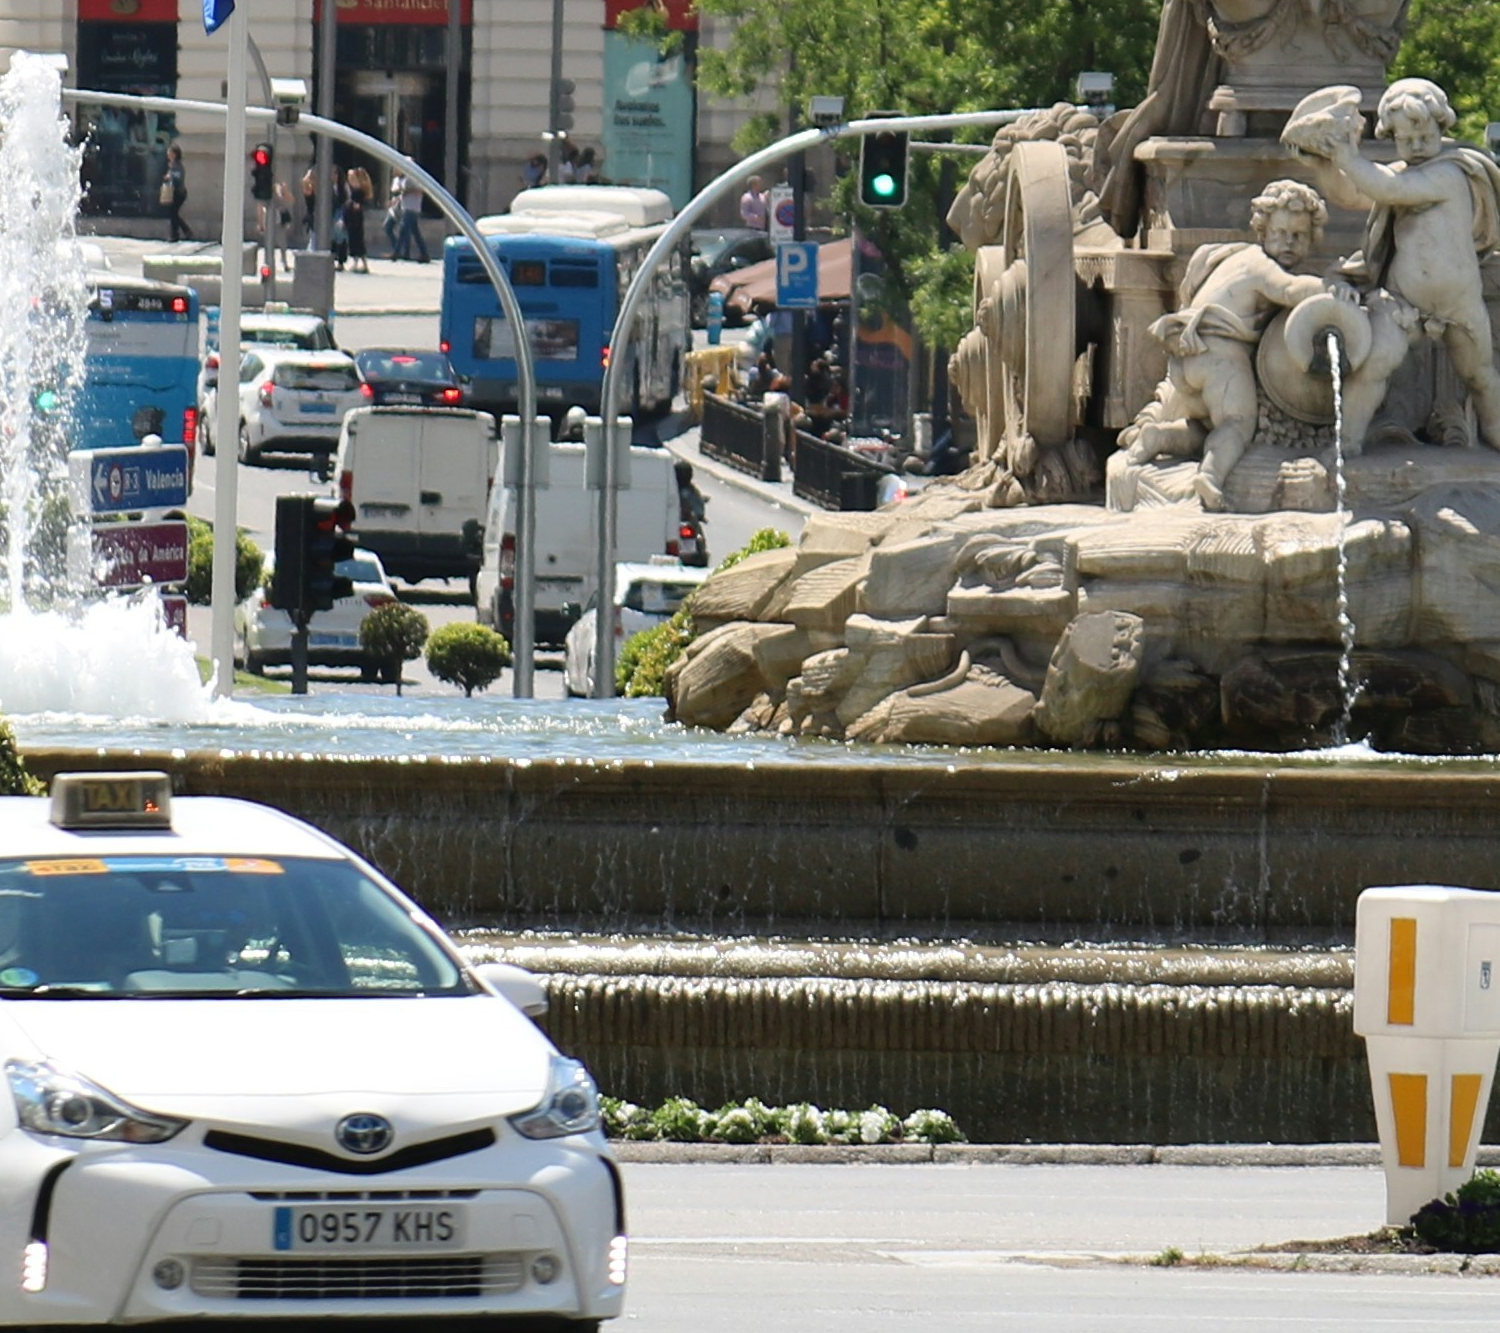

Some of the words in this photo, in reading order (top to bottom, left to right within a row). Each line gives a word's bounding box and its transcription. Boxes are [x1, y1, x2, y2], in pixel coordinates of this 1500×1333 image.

[781, 248, 808, 287] P
[145, 468, 185, 491] Valencia
[152, 541, 185, 562] América
[83, 782, 135, 811] TAXI
[299, 1212, 382, 1243] 0957
[393, 1211, 454, 1242] KHS
